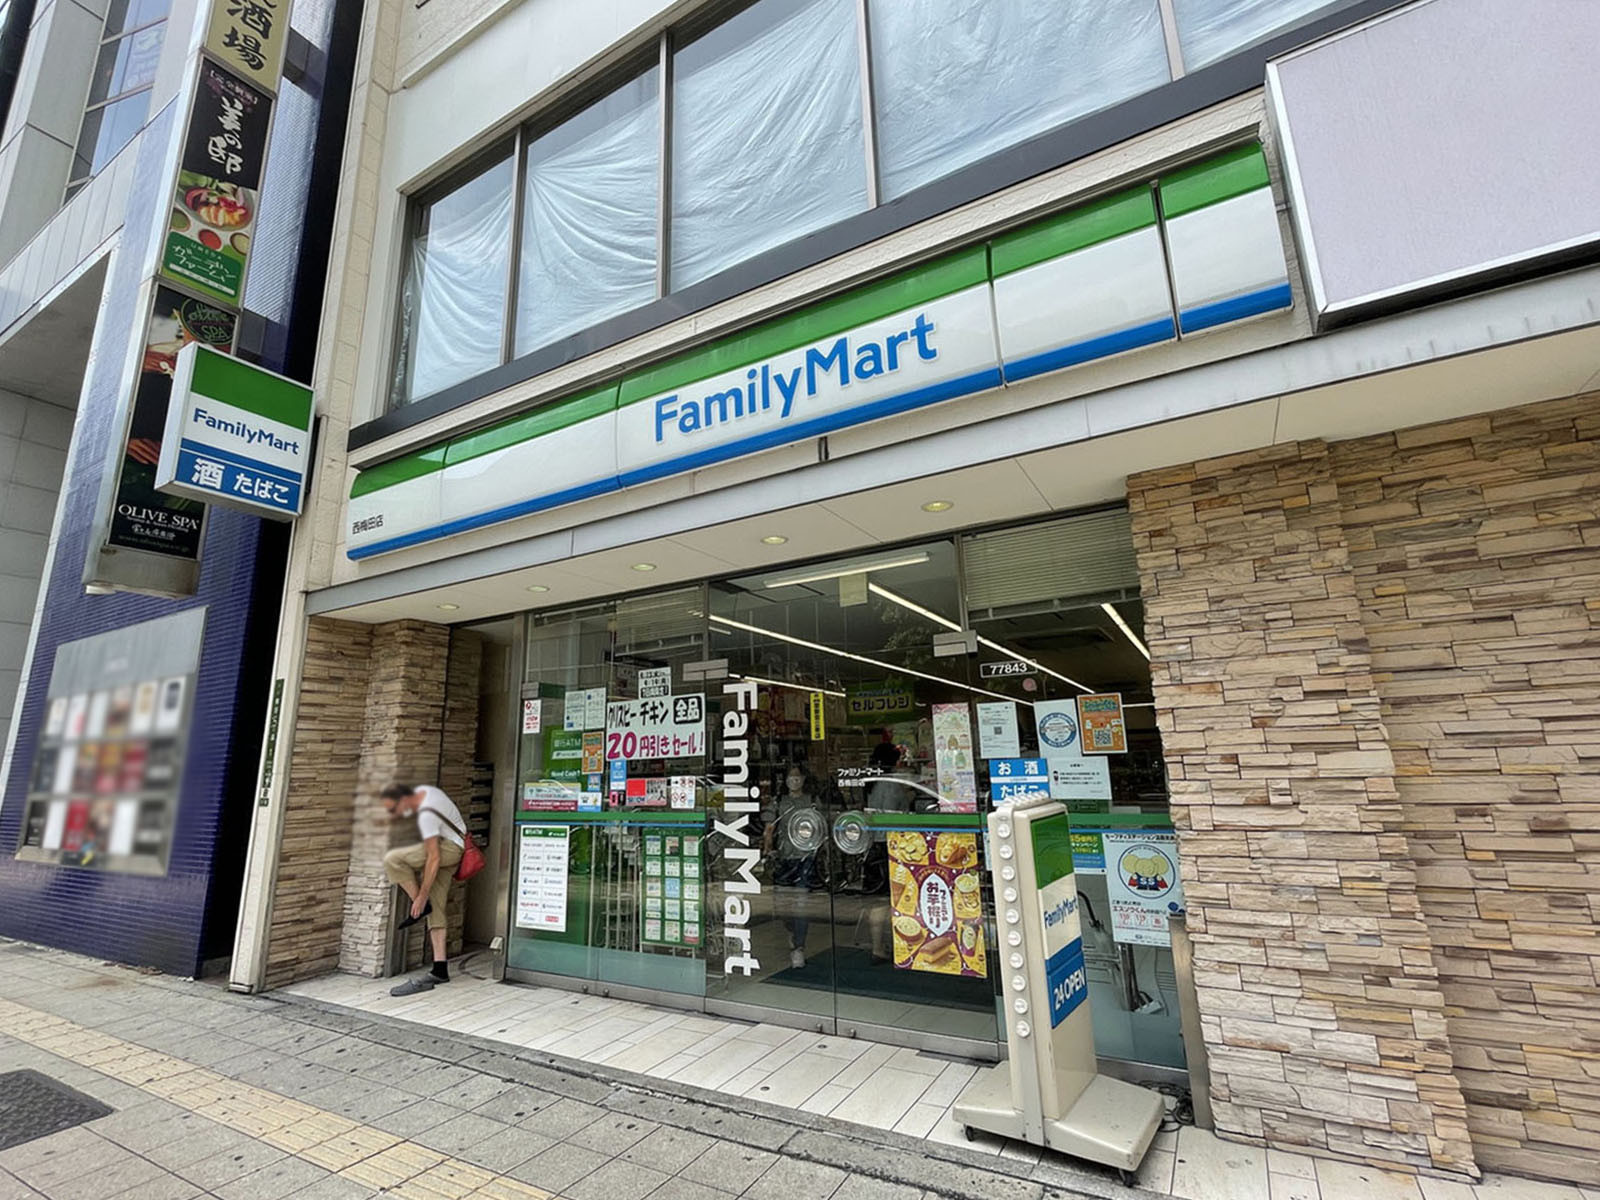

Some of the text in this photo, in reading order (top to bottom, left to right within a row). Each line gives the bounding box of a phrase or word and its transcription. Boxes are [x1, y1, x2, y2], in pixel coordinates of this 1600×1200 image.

[223, 0, 277, 70] 酒場
[655, 313, 937, 442] FamilyMart
[193, 407, 299, 455] FamilyMart
[191, 457, 289, 504] 酒 たばこ
[118, 503, 168, 524] OLIVE
[171, 515, 198, 530] SPA
[352, 514, 383, 534] 西梅田店
[990, 661, 1028, 675] 77843
[608, 701, 668, 728] クリスピーチキン
[676, 698, 699, 722] 全品
[853, 696, 909, 711] セルフレジ
[838, 768, 884, 777] ファミリーマート
[998, 761, 1039, 775] お酒
[714, 682, 761, 976] FamilyMart
[1044, 896, 1078, 929] FamilyMart
[1064, 966, 1086, 1000] OPEN
